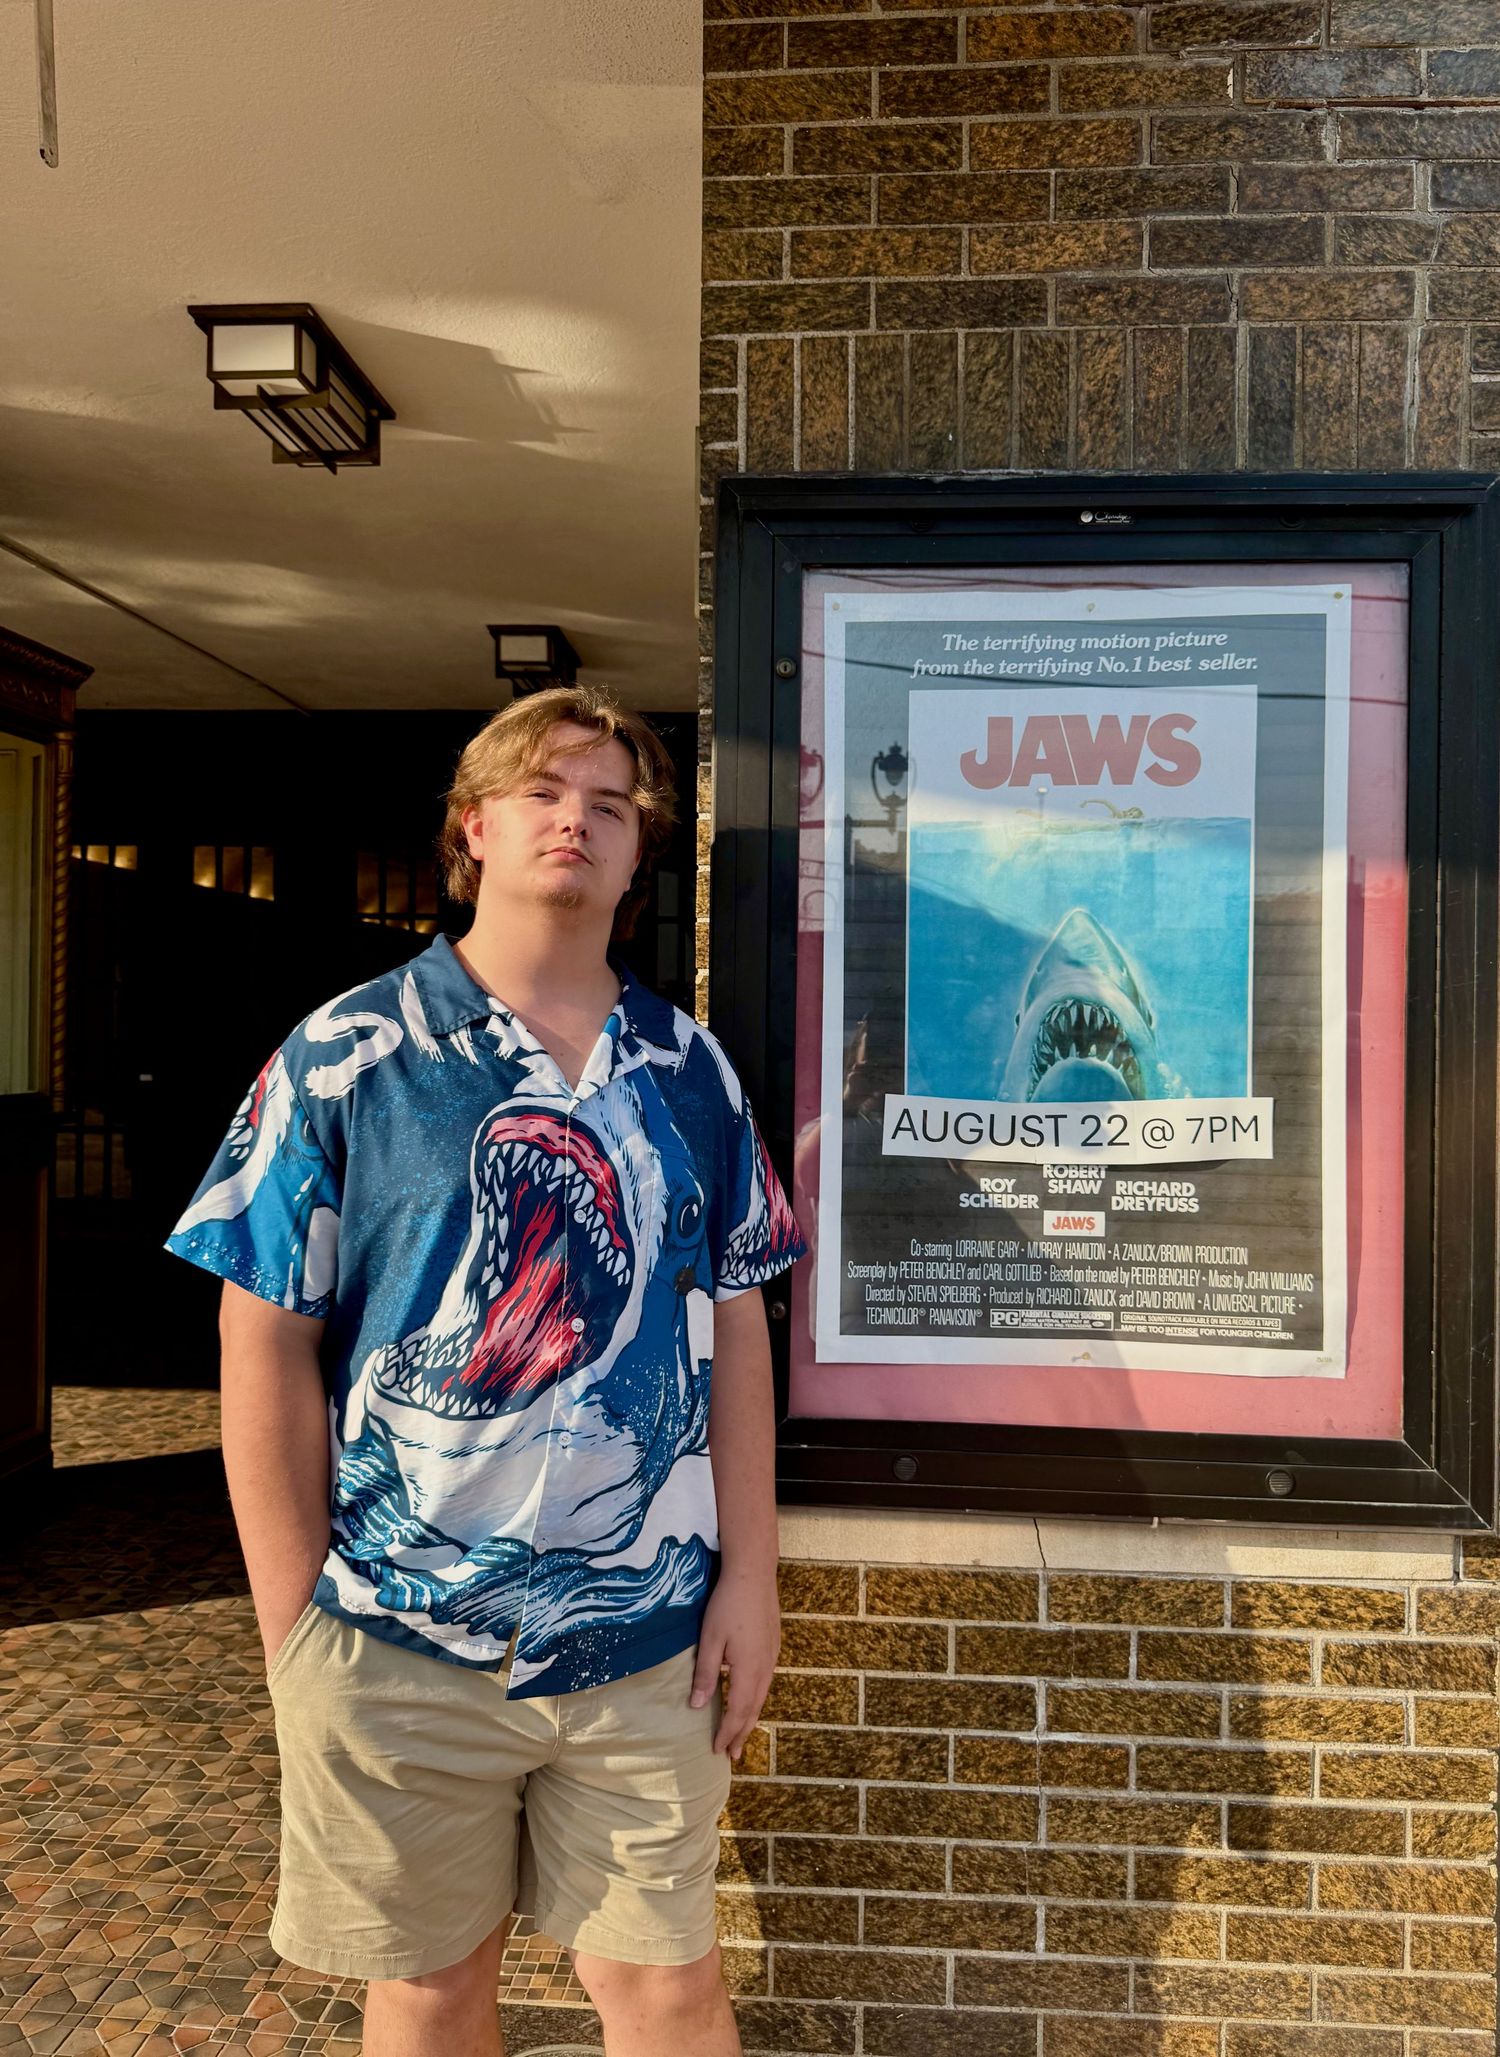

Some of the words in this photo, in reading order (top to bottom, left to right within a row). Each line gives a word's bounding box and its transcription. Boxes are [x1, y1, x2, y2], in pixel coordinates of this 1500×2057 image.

[942, 634, 979, 651] The
[983, 633, 1077, 654] terrifying
[1081, 633, 1150, 649] motion
[1153, 631, 1228, 652] picture
[909, 658, 959, 679] from
[963, 658, 995, 675] the
[998, 656, 1093, 678] terrifying
[1147, 655, 1192, 673] best
[1198, 653, 1258, 670] seller.
[959, 712, 1202, 790] JAWS
[890, 1107, 1067, 1148] AUGUST
[1080, 1114, 1130, 1147] 22
[1141, 1118, 1175, 1150] @
[1185, 1115, 1259, 1145] 7PM
[1042, 1164, 1108, 1179] ROBERT
[979, 1178, 1016, 1193] ROY
[1048, 1179, 1102, 1195] SHAW
[1115, 1180, 1196, 1197] RICHARD
[959, 1193, 1040, 1209] SCHEIDER
[1111, 1196, 1200, 1213] DREYFUSS
[1051, 1216, 1096, 1231] JAWS
[910, 1238, 952, 1261] Co-starring
[955, 1239, 996, 1258] LORRAINE
[997, 1240, 1020, 1259] GARY
[1027, 1241, 1063, 1260] MURRAY
[1065, 1242, 1106, 1260] HAMILTON
[1112, 1243, 1121, 1261] A
[1122, 1243, 1193, 1264] ZANUCK/BROWN
[1195, 1245, 1249, 1265] PRODUCTION
[847, 1260, 887, 1283] Screenplay
[888, 1260, 899, 1283] by
[899, 1261, 924, 1279] PETER
[925, 1261, 966, 1280] BENCHLEY
[967, 1263, 981, 1280] and
[983, 1262, 1004, 1281] CARL
[1005, 1263, 1042, 1282] GOTTLIEB
[1050, 1264, 1074, 1282] Based
[1074, 1268, 1085, 1283] on
[1085, 1265, 1098, 1283] the
[1098, 1266, 1119, 1284] novel
[1119, 1266, 1131, 1289] by
[1131, 1266, 1158, 1286] PETER
[1158, 1267, 1201, 1288] BENCHLEY
[1208, 1269, 1233, 1289] Music
[1233, 1270, 1244, 1293] by
[1245, 1270, 1270, 1290] JOHN
[1270, 1271, 1315, 1293] WILLIAMS
[865, 1283, 895, 1302] Directed
[896, 1284, 907, 1306] by
[907, 1284, 938, 1303] STEVEN
[939, 1285, 981, 1304] SPIELBERG
[989, 1286, 1024, 1305] Produced
[1025, 1287, 1036, 1309] by
[1036, 1287, 1073, 1306] RICHARD
[1082, 1287, 1118, 1307] ZANUCK
[1118, 1289, 1135, 1308] and
[1136, 1290, 1162, 1309] DAVID
[1162, 1291, 1196, 1310] BROWN
[1203, 1292, 1212, 1311] A
[1212, 1293, 1260, 1313] UNIVERSAL
[1260, 1294, 1297, 1315] PICTURE
[991, 1311, 1019, 1327] PG
[1121, 1324, 1136, 1333] MAY
[1137, 1325, 1148, 1333] BE
[1148, 1325, 1165, 1334] TOO
[1165, 1326, 1199, 1336] INTENSE
[1200, 1328, 1217, 1337] FOR
[1217, 1329, 1254, 1338] YOUNGER
[1254, 1330, 1294, 1340] CHILDREN
